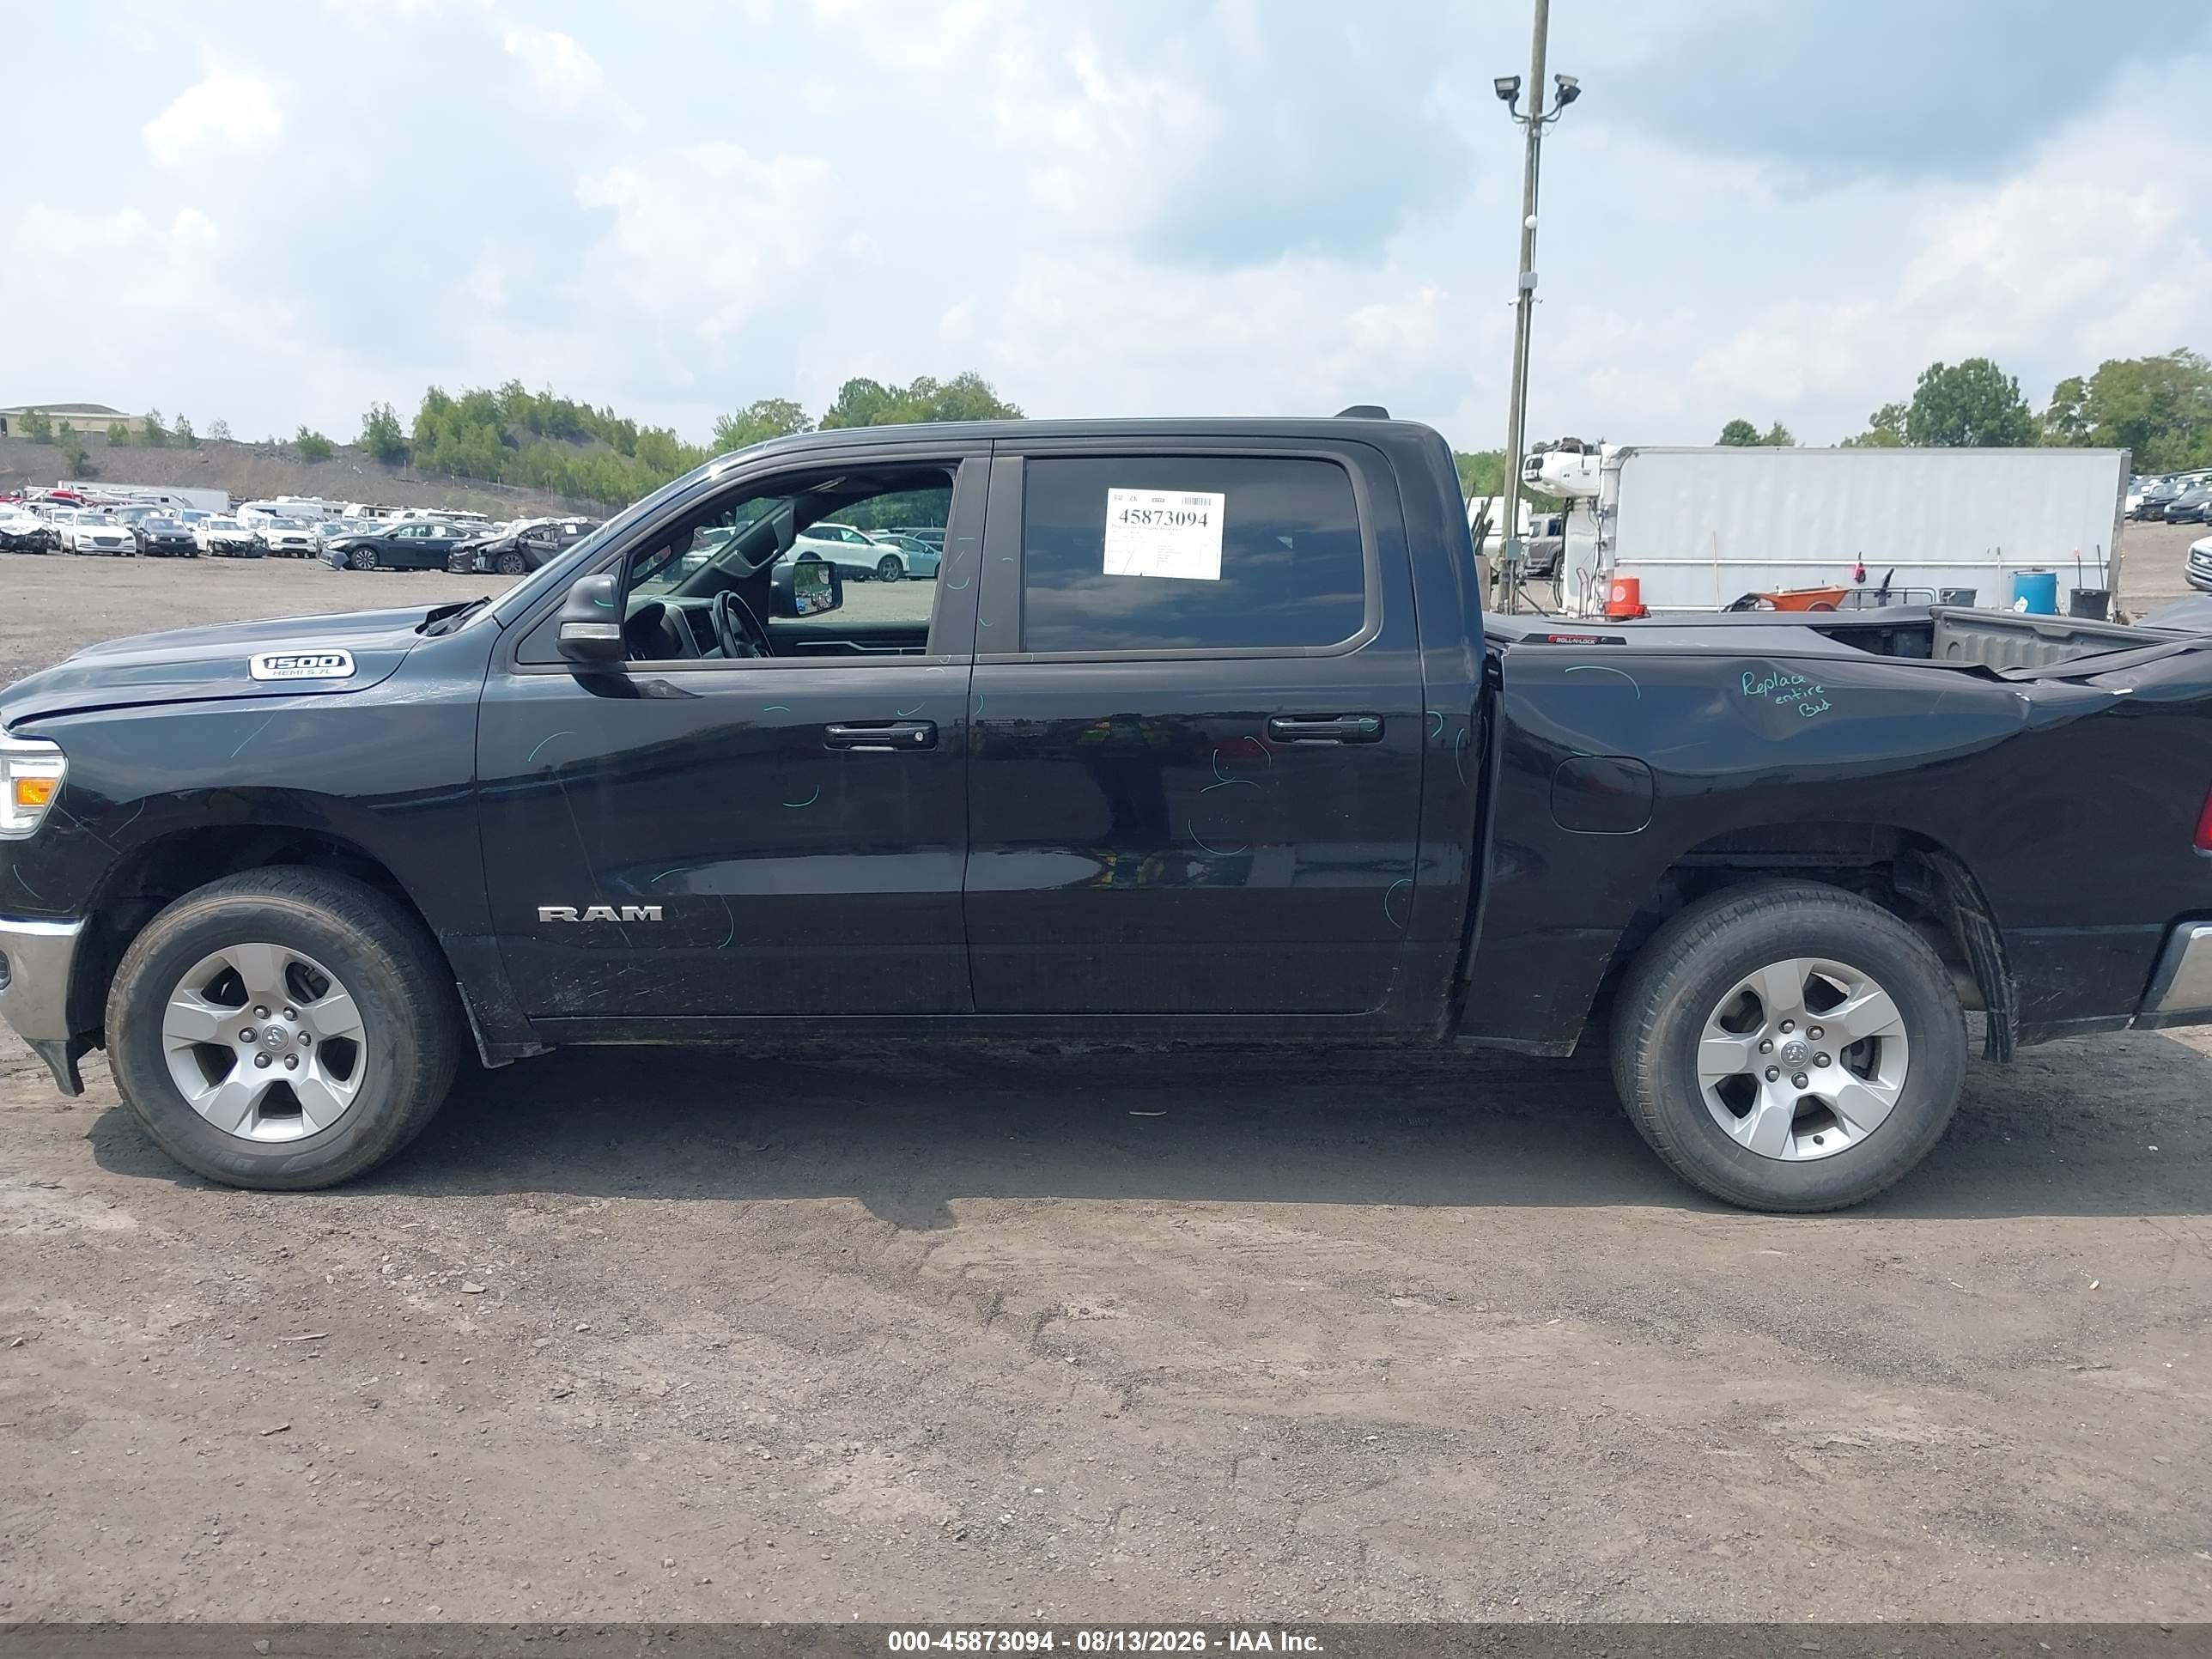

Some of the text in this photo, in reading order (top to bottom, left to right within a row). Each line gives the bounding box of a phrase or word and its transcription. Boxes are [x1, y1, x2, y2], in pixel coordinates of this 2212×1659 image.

[1119, 508, 1208, 528] 45873094
[265, 655, 342, 669] 1500
[1741, 672, 1807, 696] Replace
[1775, 684, 1826, 704] entire
[1798, 698, 1832, 717] Bed
[538, 906, 663, 922] RAM
